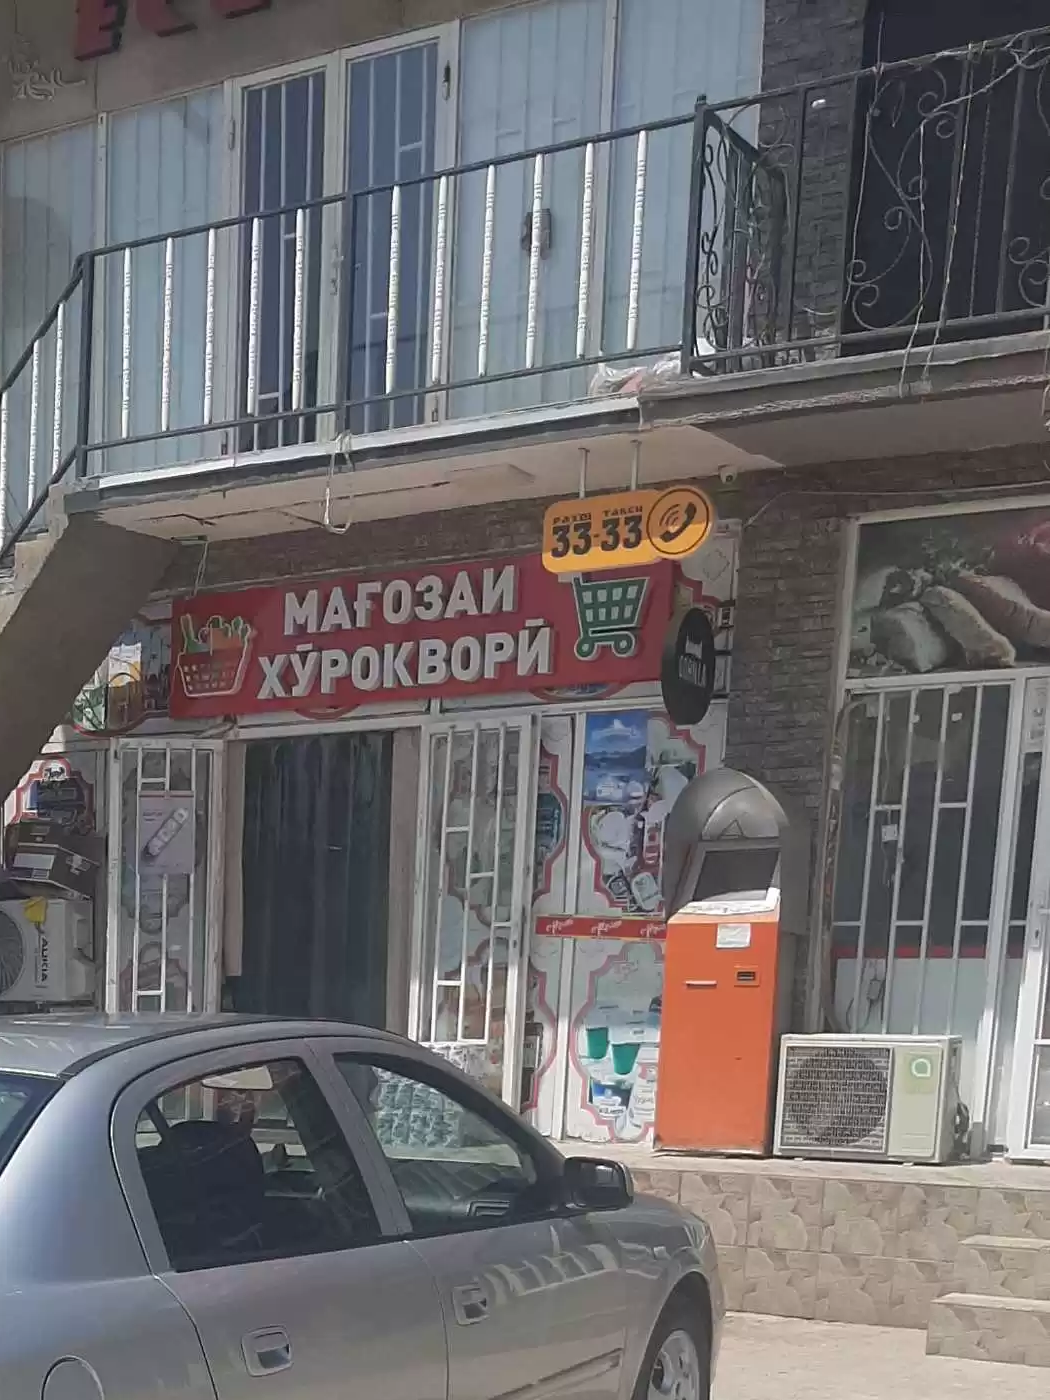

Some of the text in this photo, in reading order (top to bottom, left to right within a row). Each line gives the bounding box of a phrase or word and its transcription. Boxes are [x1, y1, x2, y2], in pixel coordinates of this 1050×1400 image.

[550, 515, 643, 558] 33-33
[602, 505, 643, 517] ТАКСИ
[283, 564, 519, 636] МАҒОЗАИ
[256, 618, 554, 700] ХӮРОКВОРӢ
